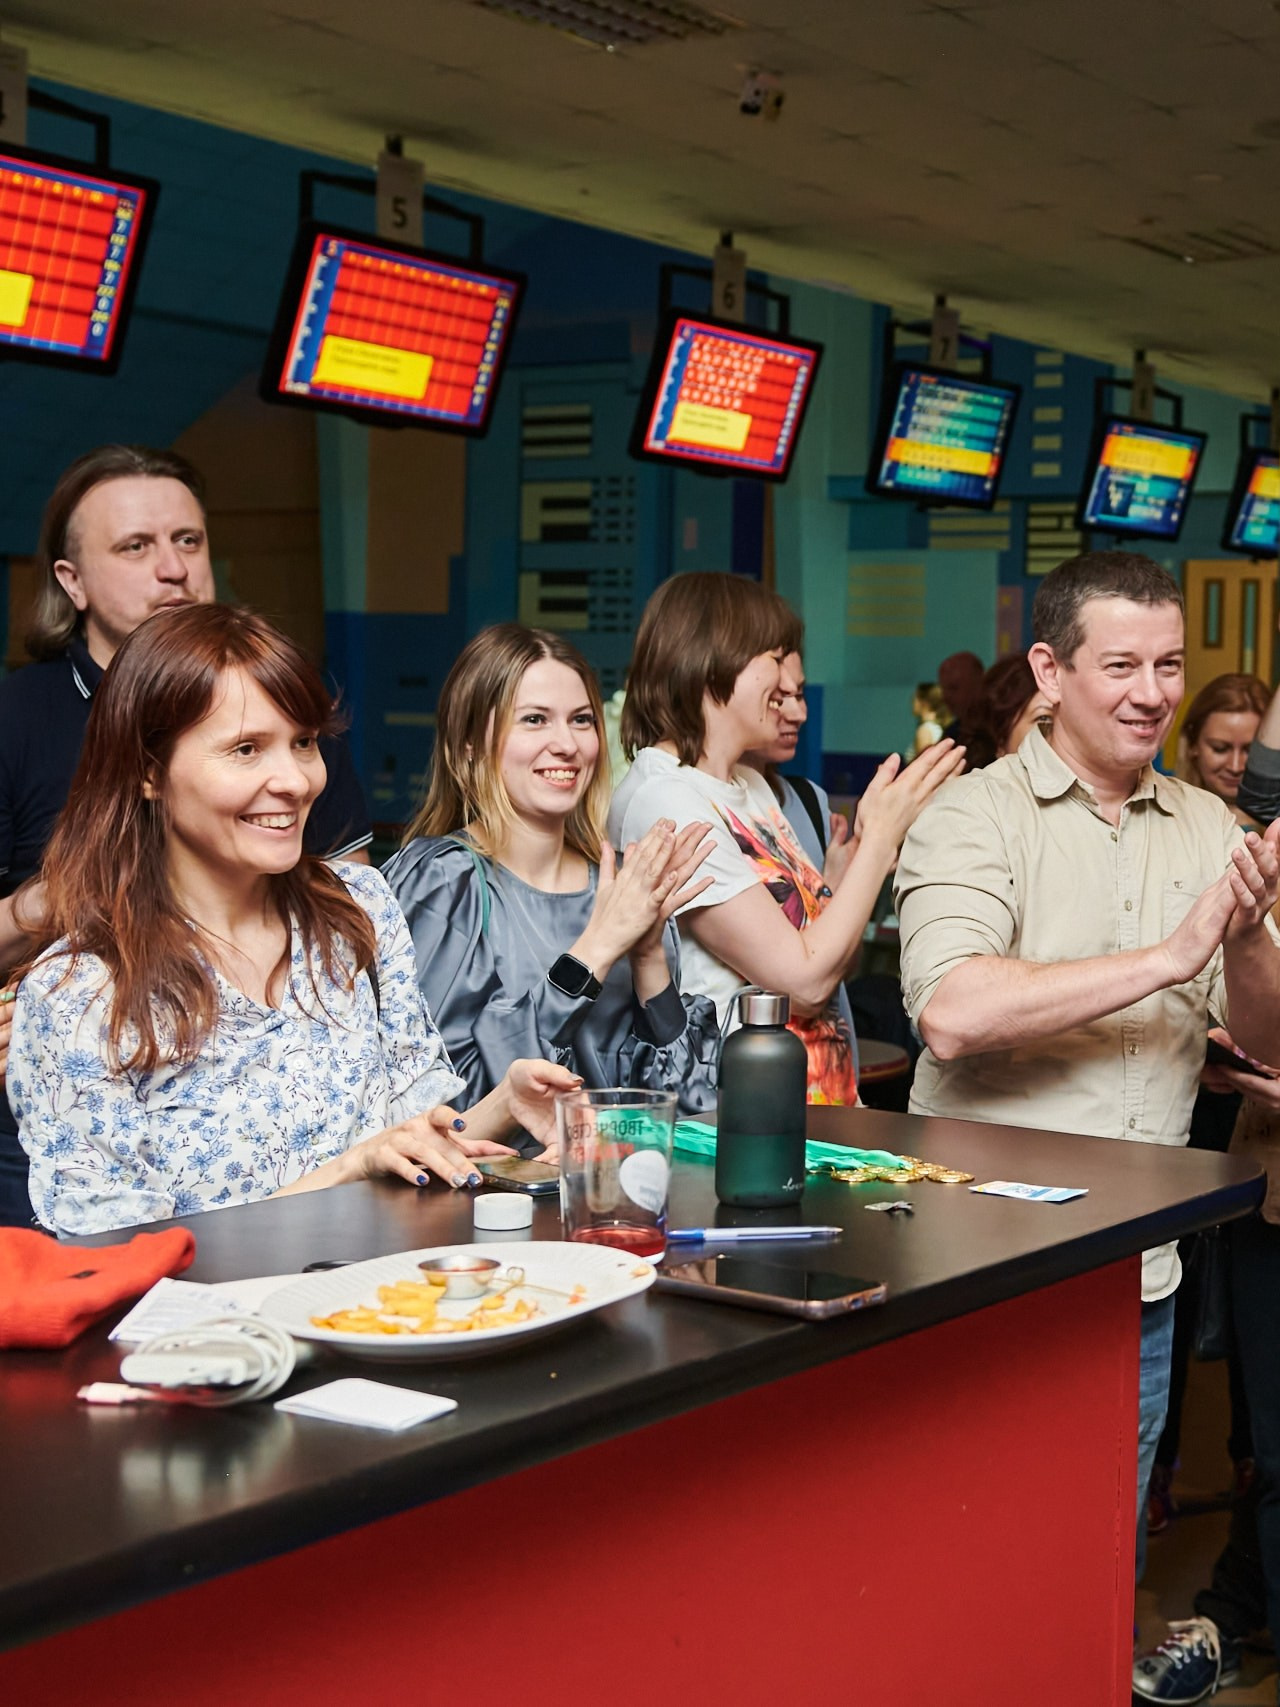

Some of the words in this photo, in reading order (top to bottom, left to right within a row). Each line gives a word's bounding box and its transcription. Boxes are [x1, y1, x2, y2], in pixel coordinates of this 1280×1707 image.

[391, 197, 408, 228] 5
[722, 283, 736, 309] 6
[940, 337, 950, 360] 7
